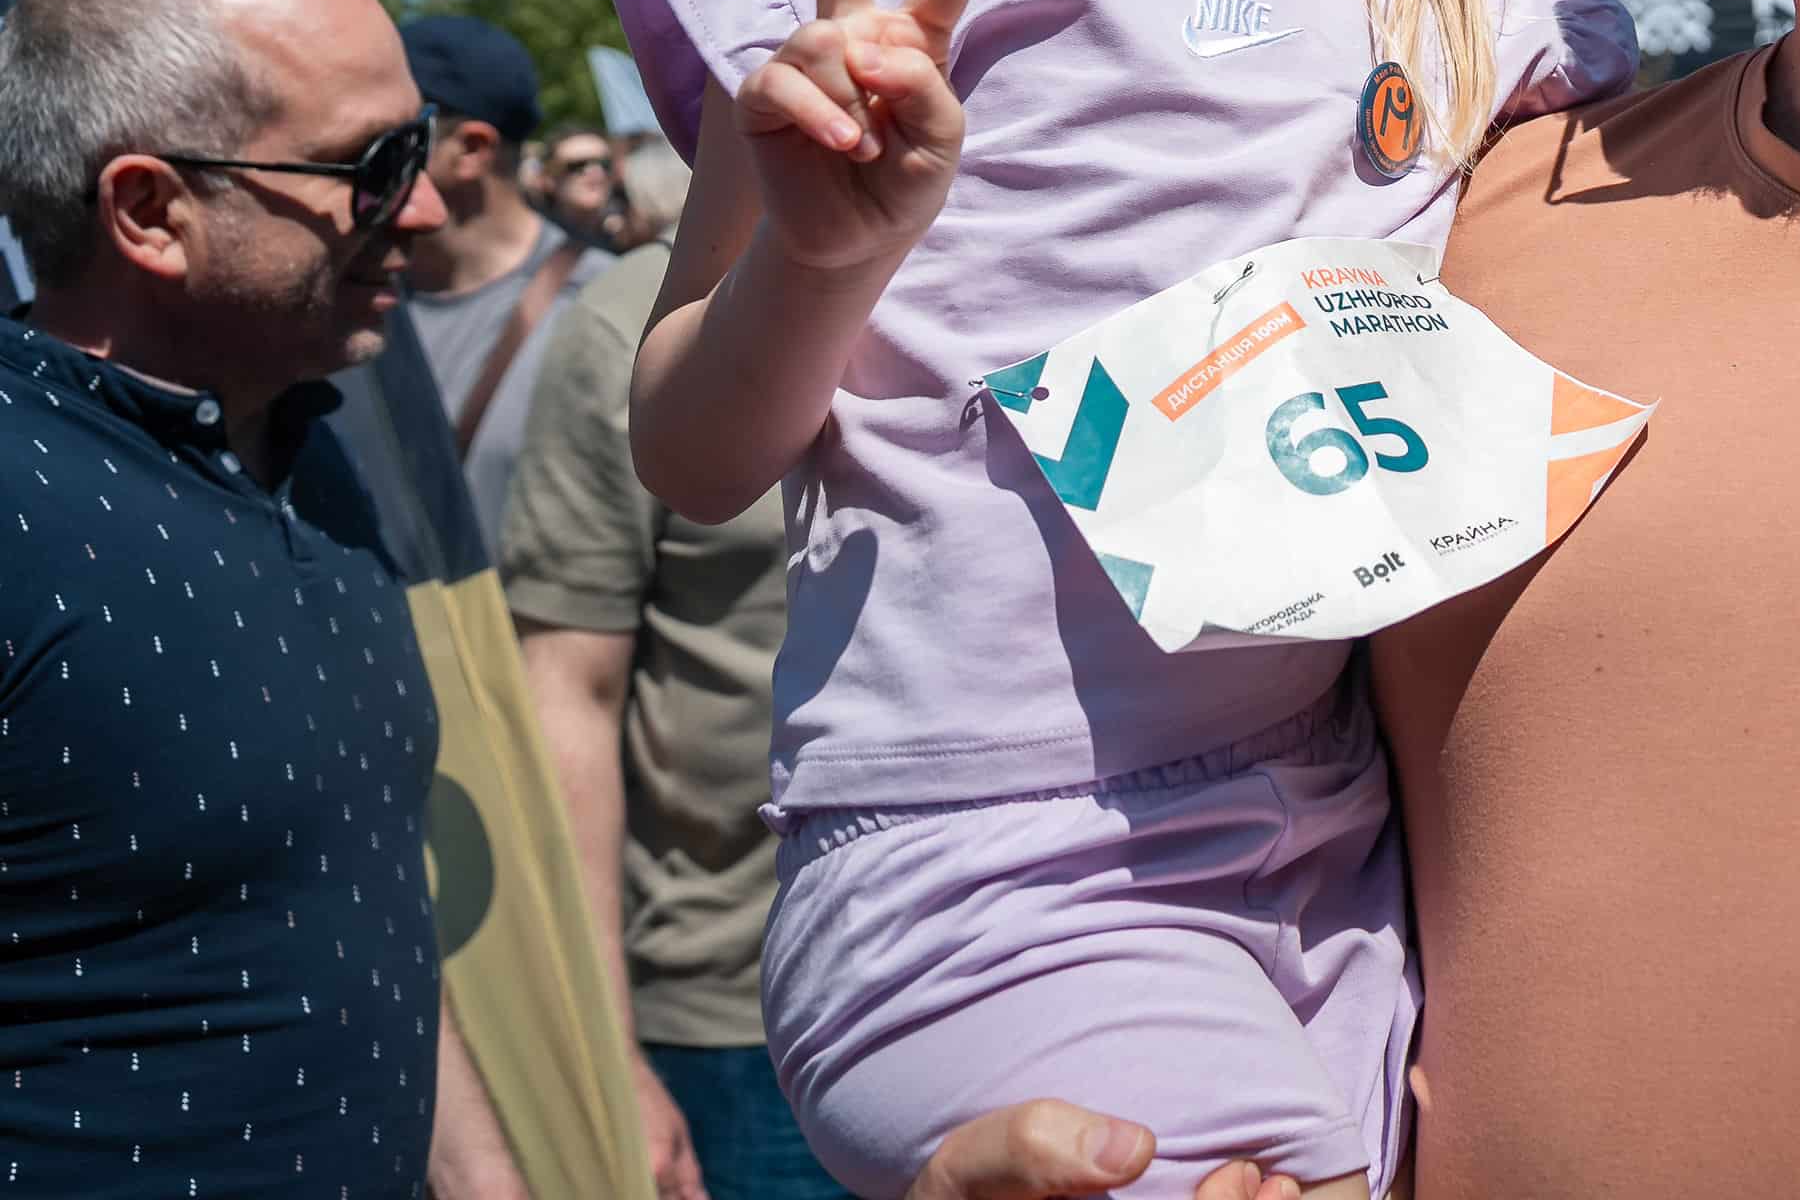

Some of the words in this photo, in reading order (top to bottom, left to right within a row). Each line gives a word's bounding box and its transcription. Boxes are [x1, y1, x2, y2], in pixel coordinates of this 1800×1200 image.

[1301, 267, 1389, 289] KRAYNA
[1314, 289, 1432, 313] UZHHOROD
[1330, 313, 1449, 338] MARATHON
[1167, 337, 1254, 411] ДИСТАНЦІЯ
[1265, 381, 1429, 496] 65
[1430, 517, 1514, 550] КРАЙНА
[1352, 551, 1405, 588] Bolt
